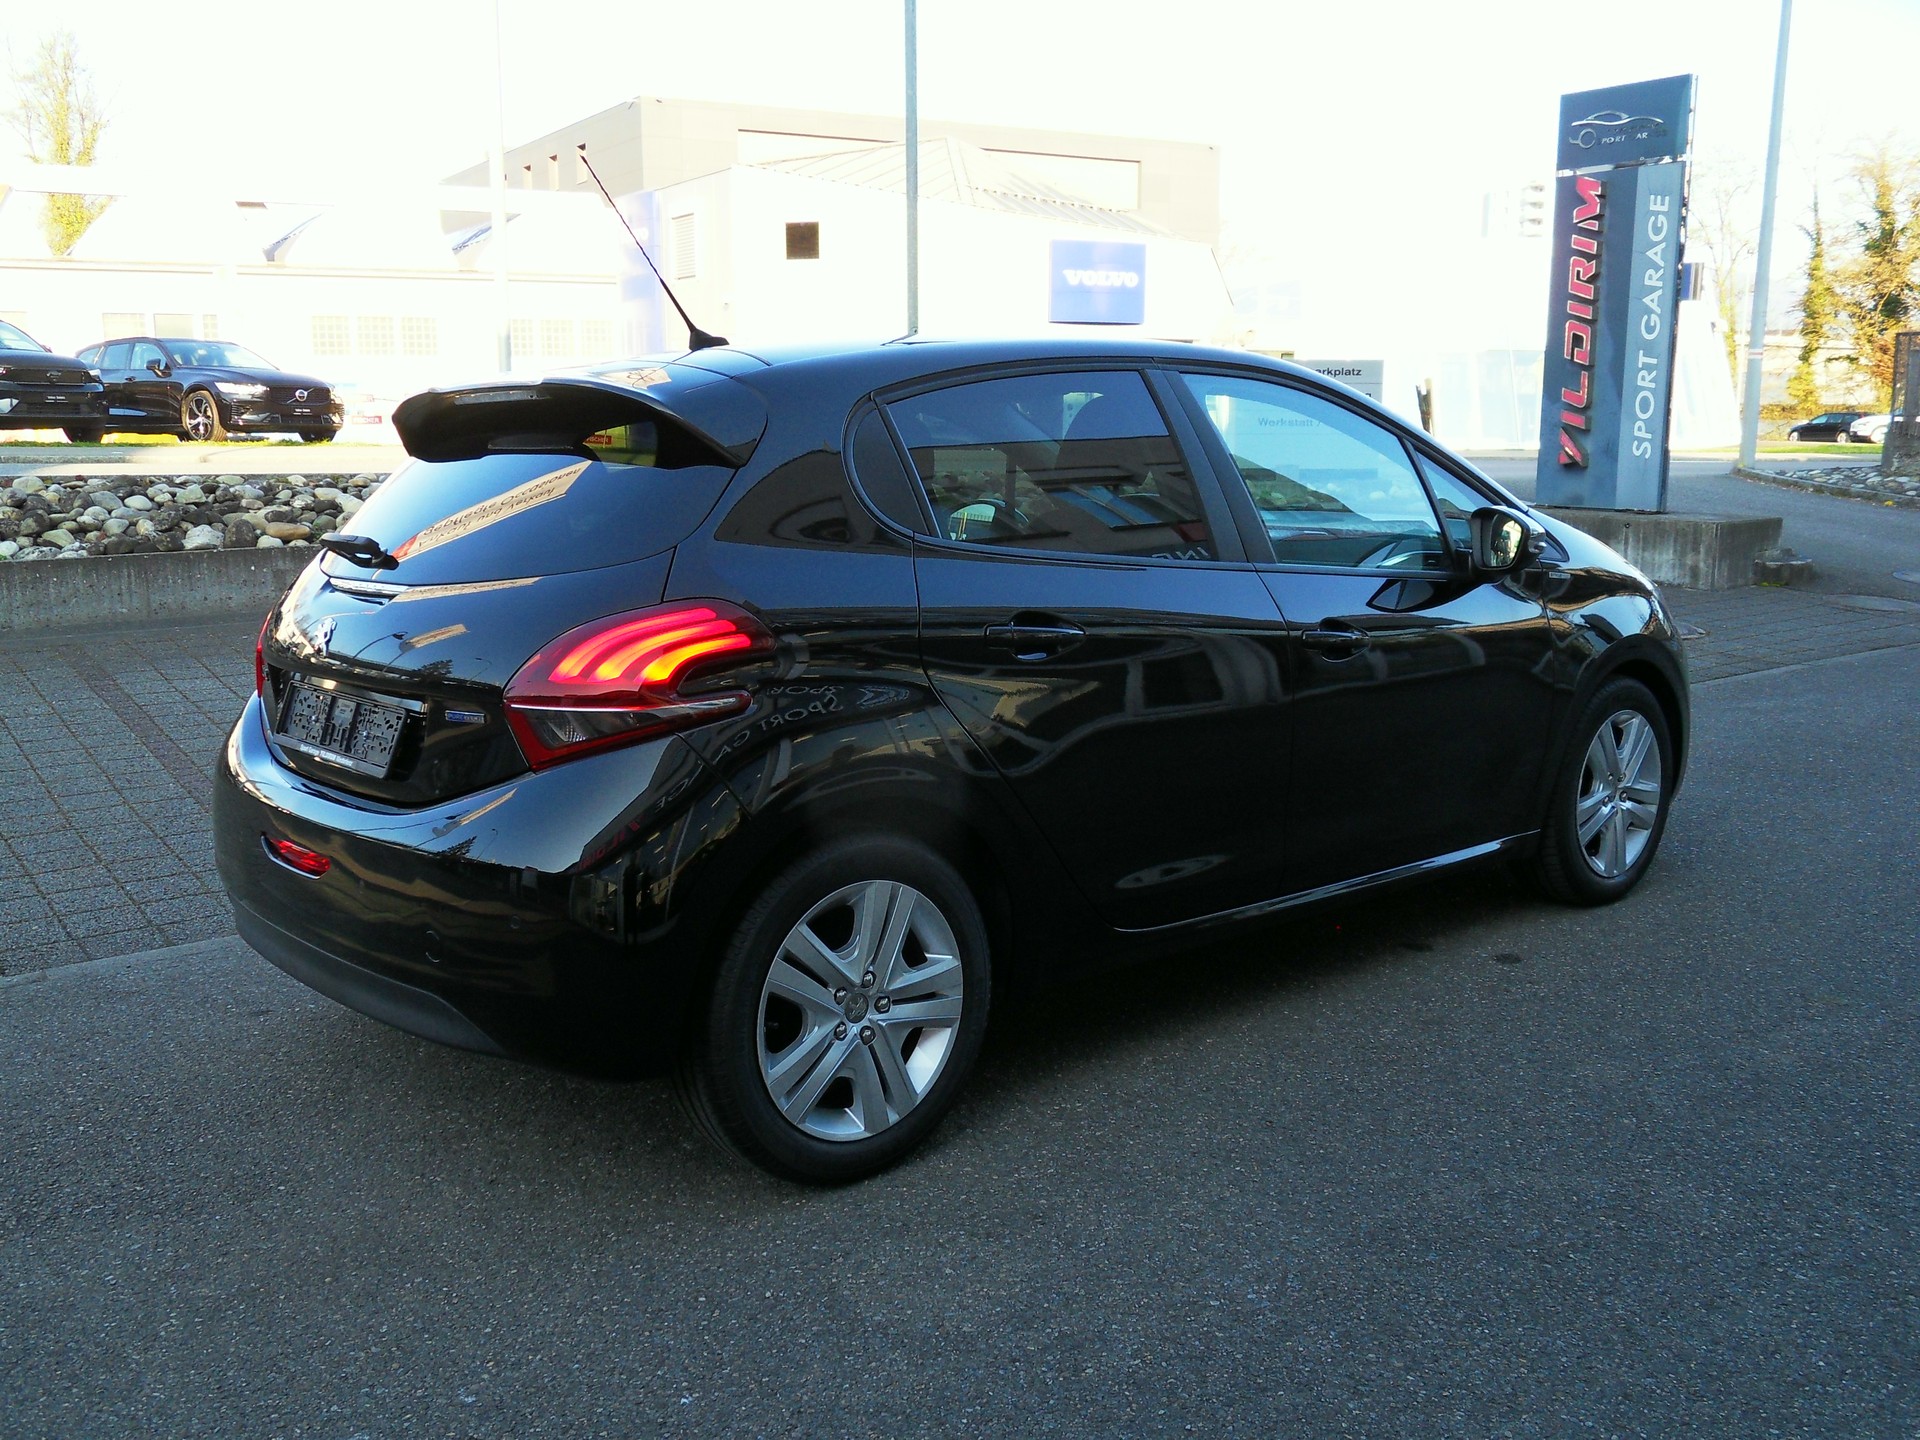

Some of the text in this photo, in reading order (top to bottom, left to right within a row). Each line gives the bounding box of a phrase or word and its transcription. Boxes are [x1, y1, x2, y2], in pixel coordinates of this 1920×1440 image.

[1062, 269, 1139, 288] VOLVO
[1558, 176, 1603, 466] YILDIRIM
[1632, 194, 1670, 459] SPORT GARAGE
[1314, 367, 1362, 378] arkplatz
[1258, 417, 1313, 427] Werkstatt
